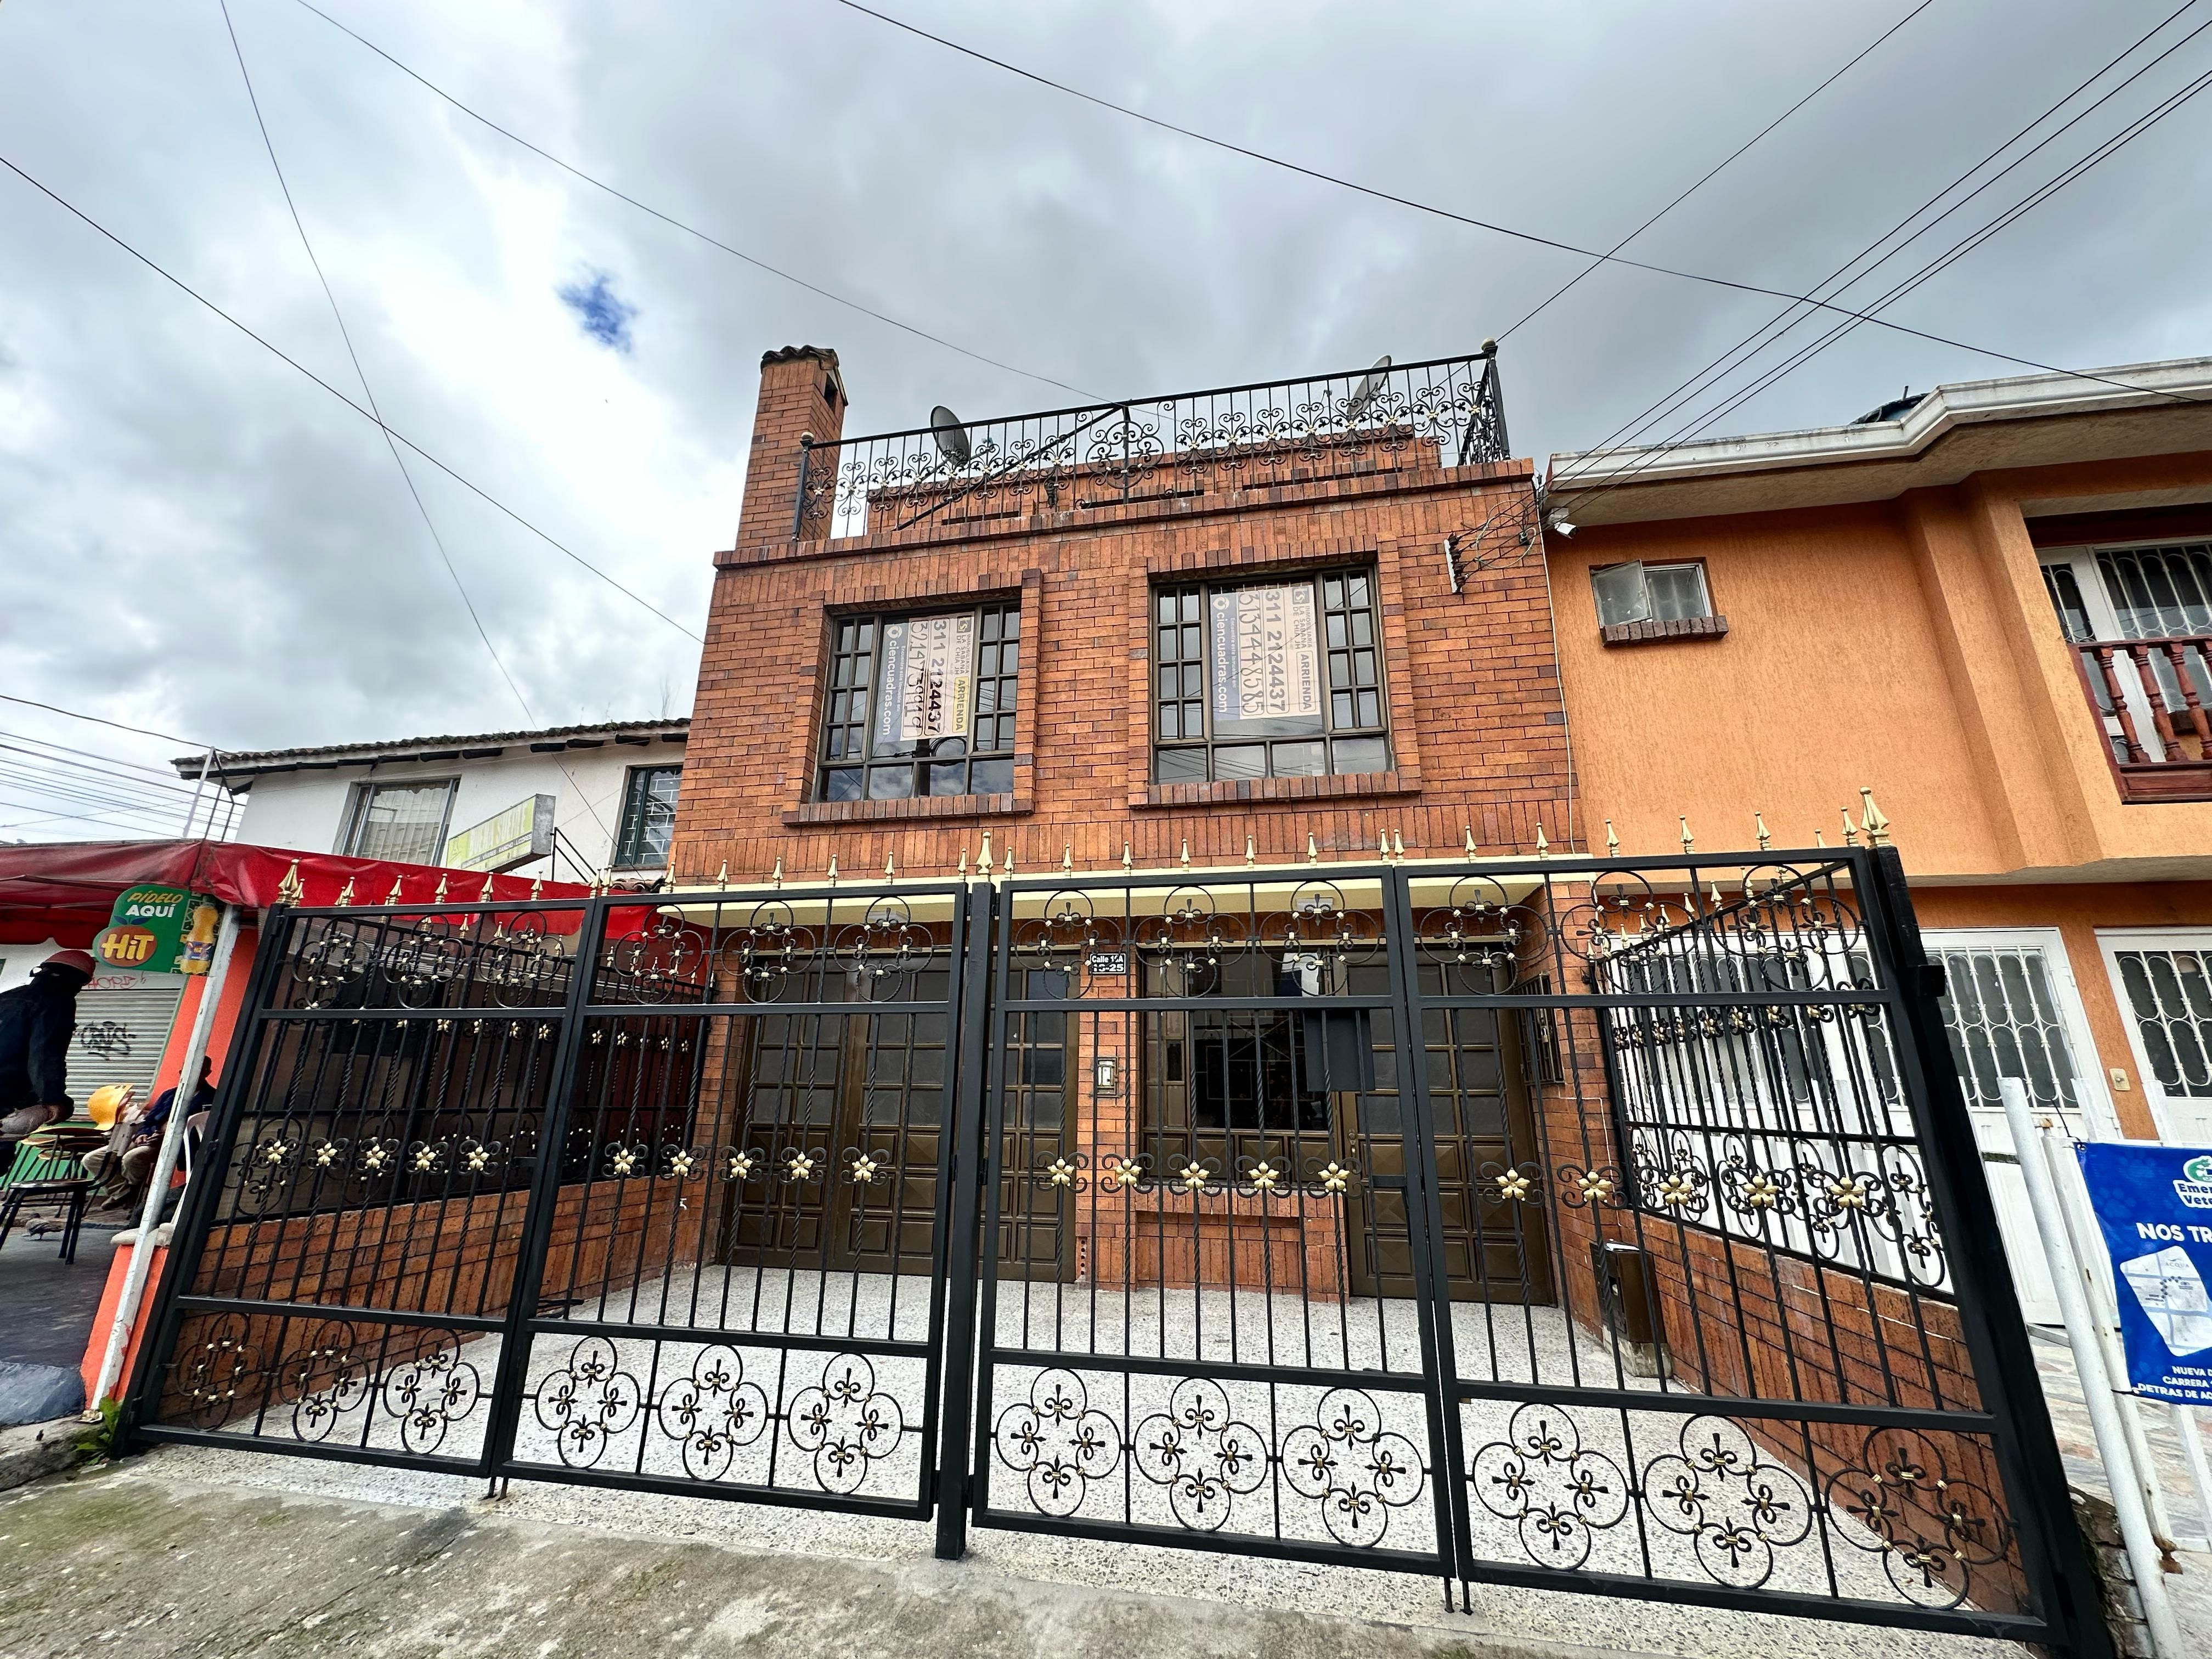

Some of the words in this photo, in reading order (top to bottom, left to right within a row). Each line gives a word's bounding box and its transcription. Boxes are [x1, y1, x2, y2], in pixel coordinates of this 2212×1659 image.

[1265, 591, 1281, 622] 311
[1293, 606, 1299, 616] DE
[1299, 606, 1305, 615] LA
[933, 621, 946, 650] 311
[956, 635, 962, 645] DE
[961, 635, 966, 644] LA
[1295, 640, 1301, 650] JH
[1216, 612, 1229, 713] ciencuadras.com
[955, 666, 960, 675] JH
[1267, 630, 1285, 711] 2124437
[882, 640, 899, 735] ciencuadras.com
[1300, 653, 1312, 710] ARRIENDA
[928, 657, 945, 733] 2124437
[956, 680, 966, 731] ARRIENDA
[127, 890, 184, 903] PÍDELO
[125, 904, 176, 917] AQUÍ
[2136, 1222, 2185, 1242] NOS
[2186, 1226, 2212, 1243] TR
[2171, 1366, 2206, 1376] NUEVA
[2162, 1376, 2210, 1388] CARRERA
[2137, 1383, 2183, 1397] DETRAS
[2185, 1390, 2199, 1398] DE
